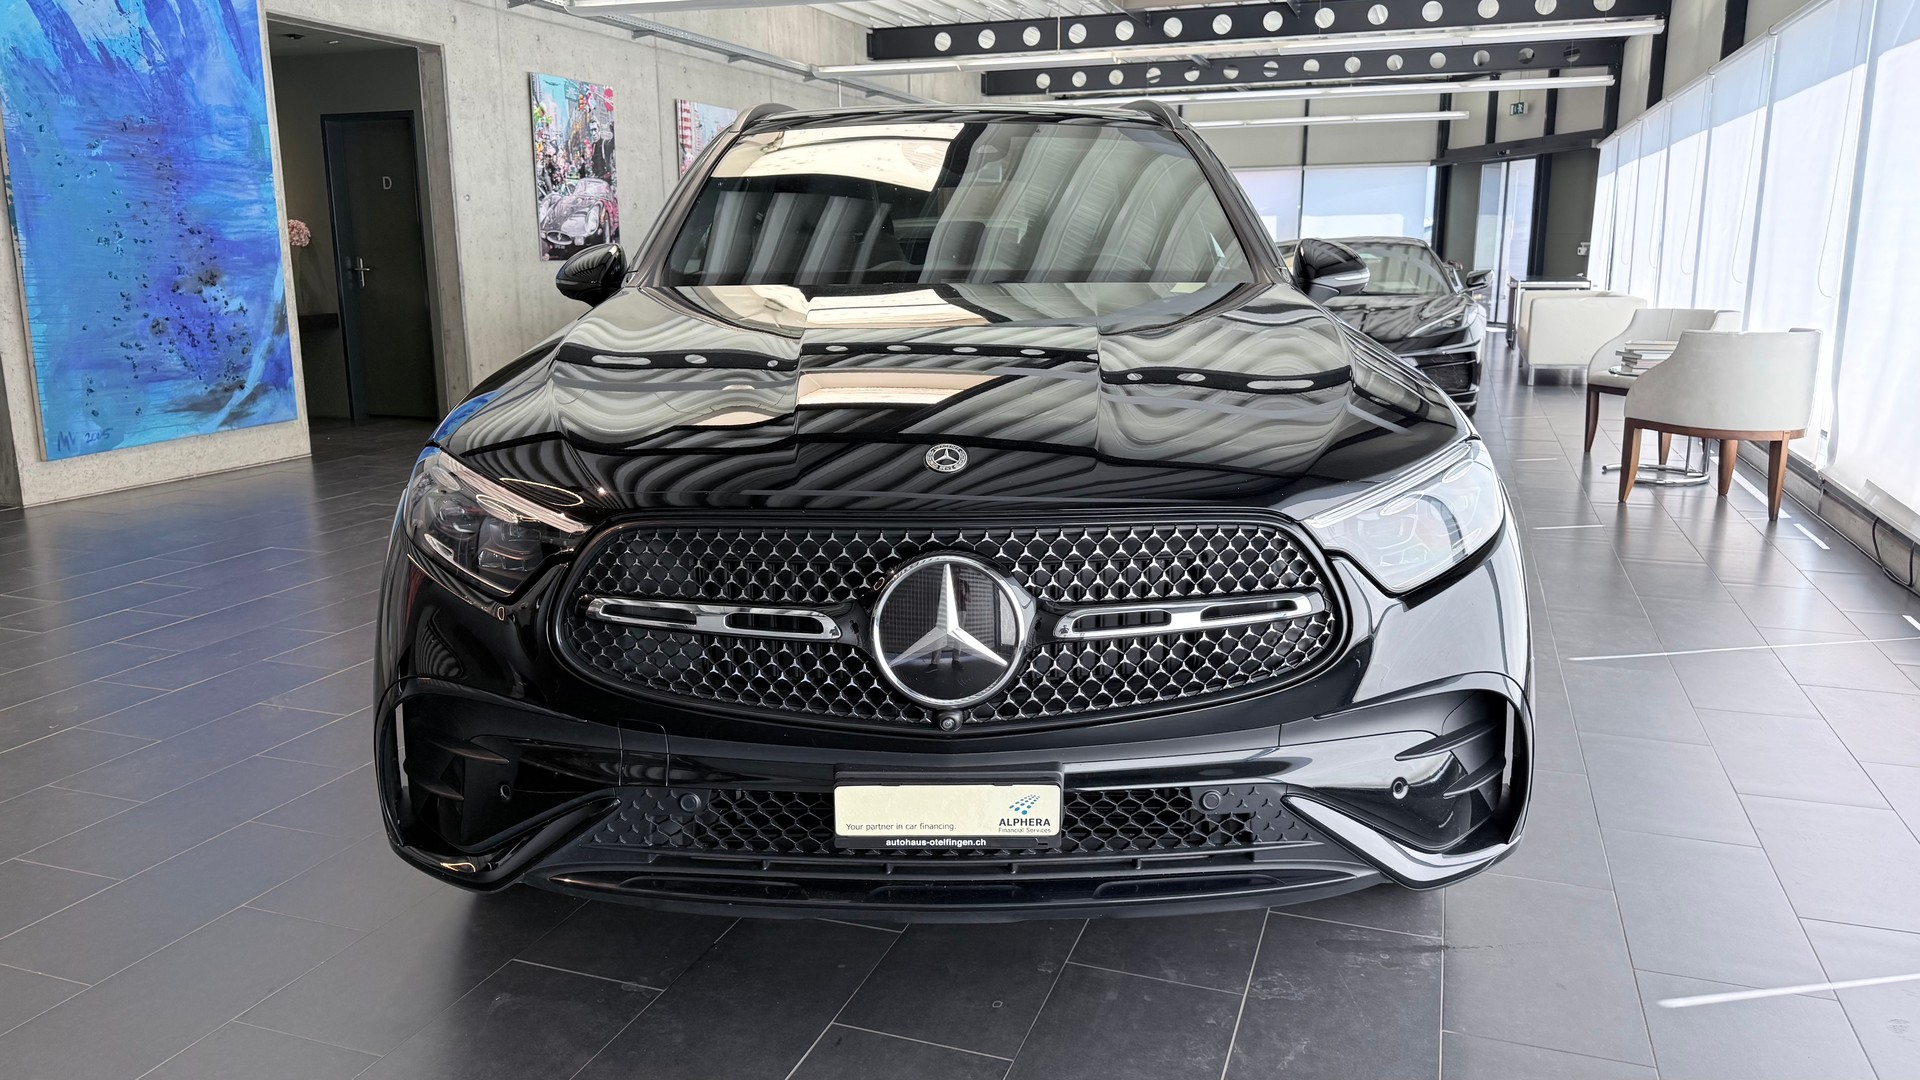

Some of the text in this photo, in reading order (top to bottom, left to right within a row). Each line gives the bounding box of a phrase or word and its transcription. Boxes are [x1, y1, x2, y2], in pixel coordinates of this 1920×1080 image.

[382, 176, 392, 190] D
[845, 823, 864, 831] Your
[865, 823, 894, 832] partner
[896, 822, 903, 830] in
[919, 822, 957, 832] financing.
[998, 818, 1051, 827] ALPHERA
[885, 838, 987, 848] autohaus-otelfingen.ch
